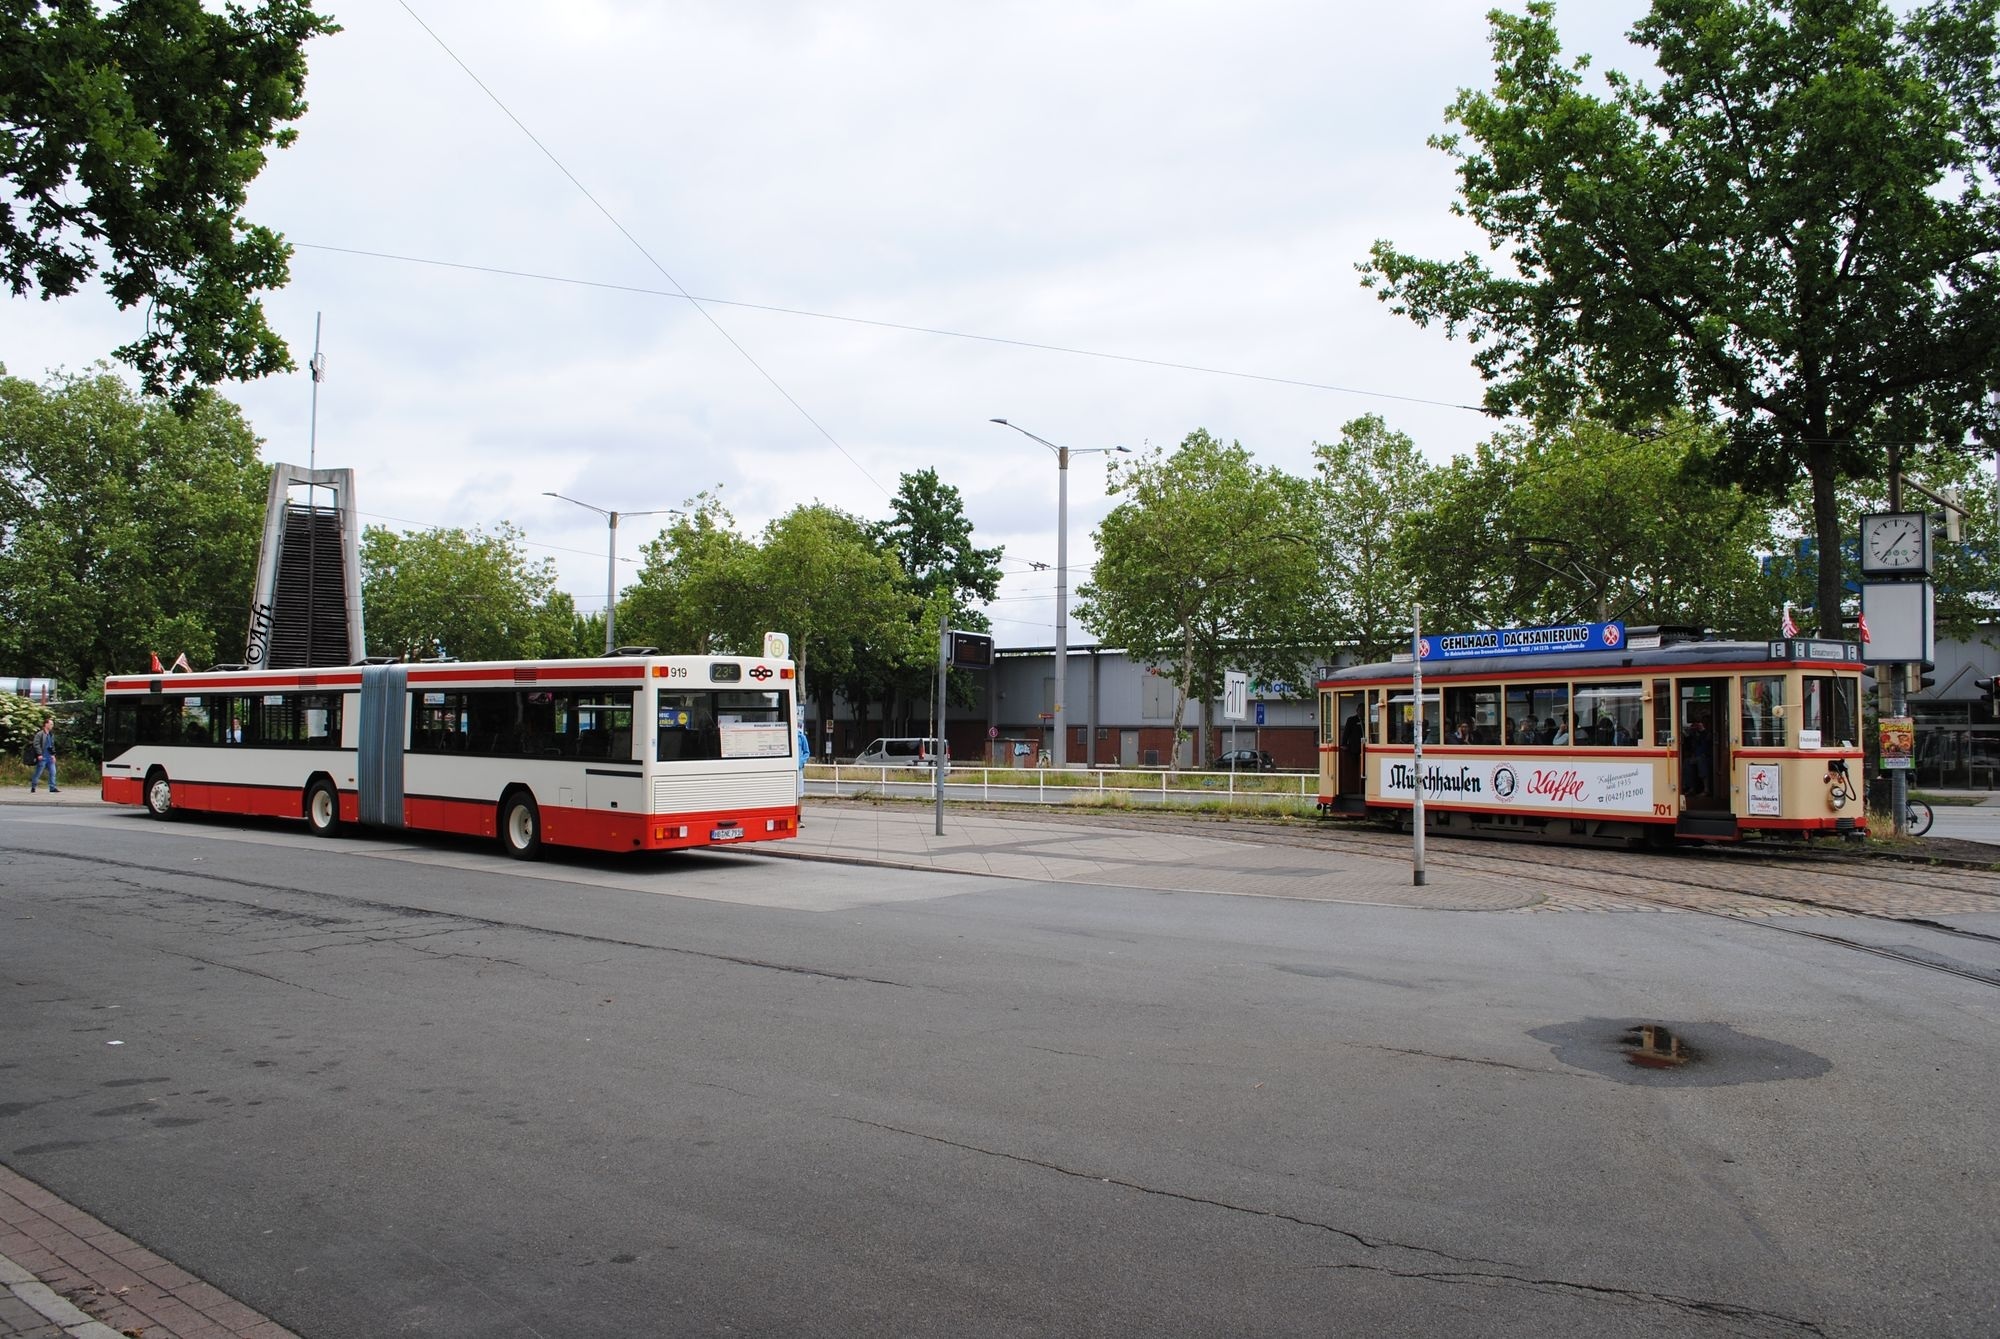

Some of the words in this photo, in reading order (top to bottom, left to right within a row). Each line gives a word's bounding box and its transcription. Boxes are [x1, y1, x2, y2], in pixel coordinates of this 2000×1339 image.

[1441, 634, 1498, 650] GEHLHAAR
[1504, 627, 1588, 646] DACHSANIERUNG
[1776, 643, 1782, 657] E
[1798, 643, 1803, 657] E
[1849, 646, 1855, 660] E
[670, 667, 688, 678] 919
[1527, 770, 1589, 802] Kaffee
[1653, 804, 1671, 816] 701
